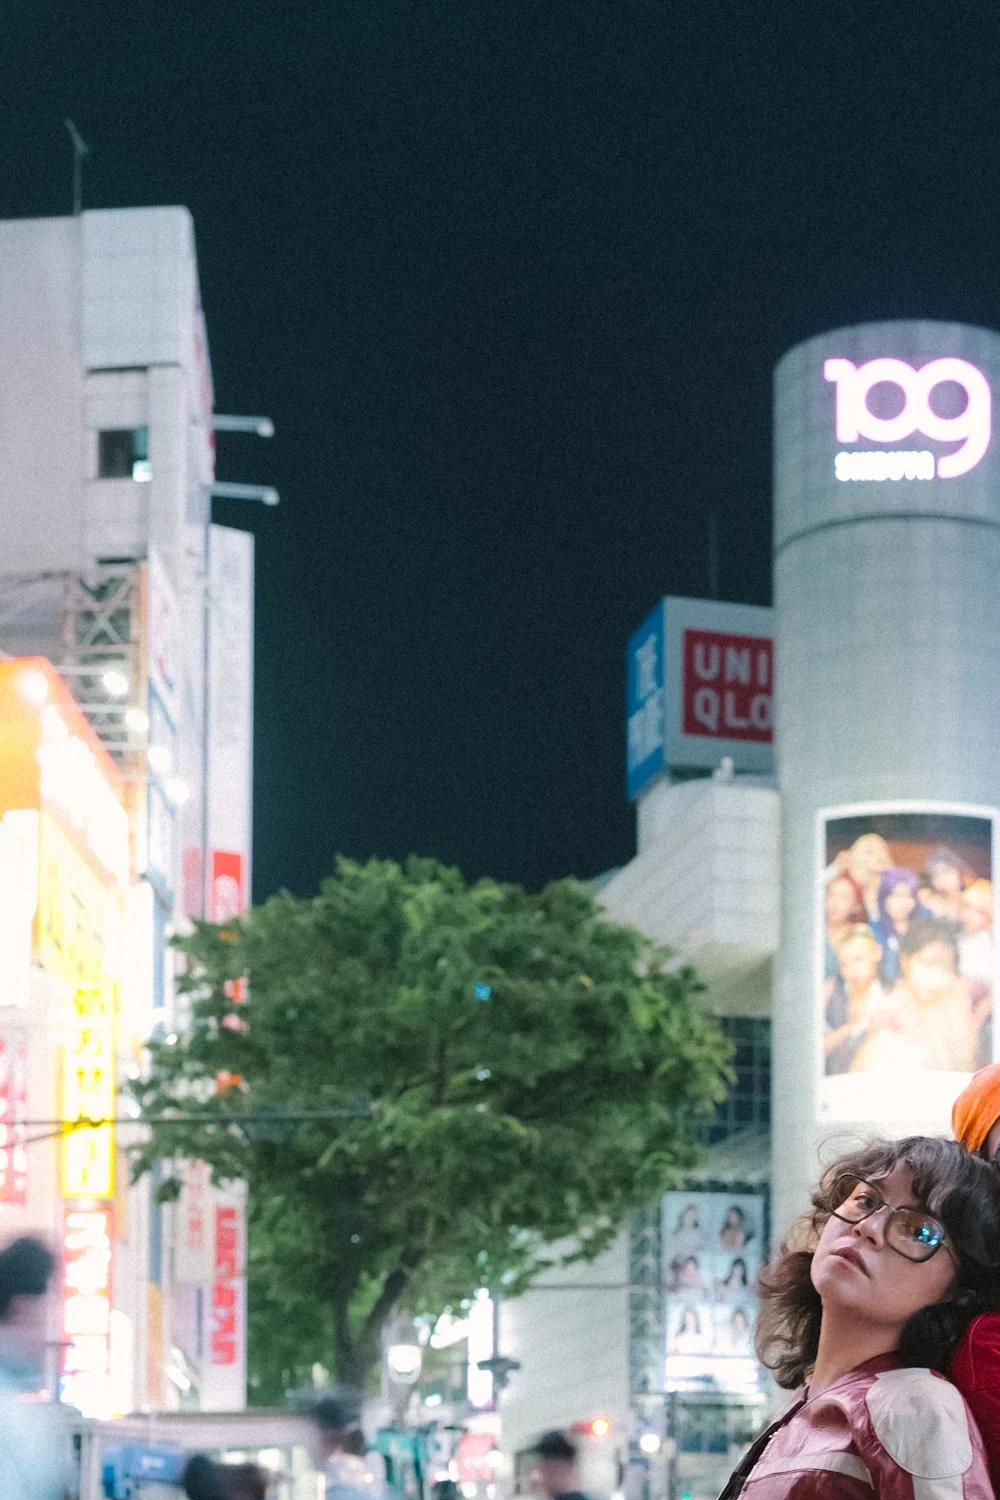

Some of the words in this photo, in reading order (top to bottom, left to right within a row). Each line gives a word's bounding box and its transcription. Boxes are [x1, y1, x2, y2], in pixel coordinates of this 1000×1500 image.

[824, 357, 991, 479] 109
[694, 643, 769, 687] UNI
[694, 688, 774, 732] QLO
